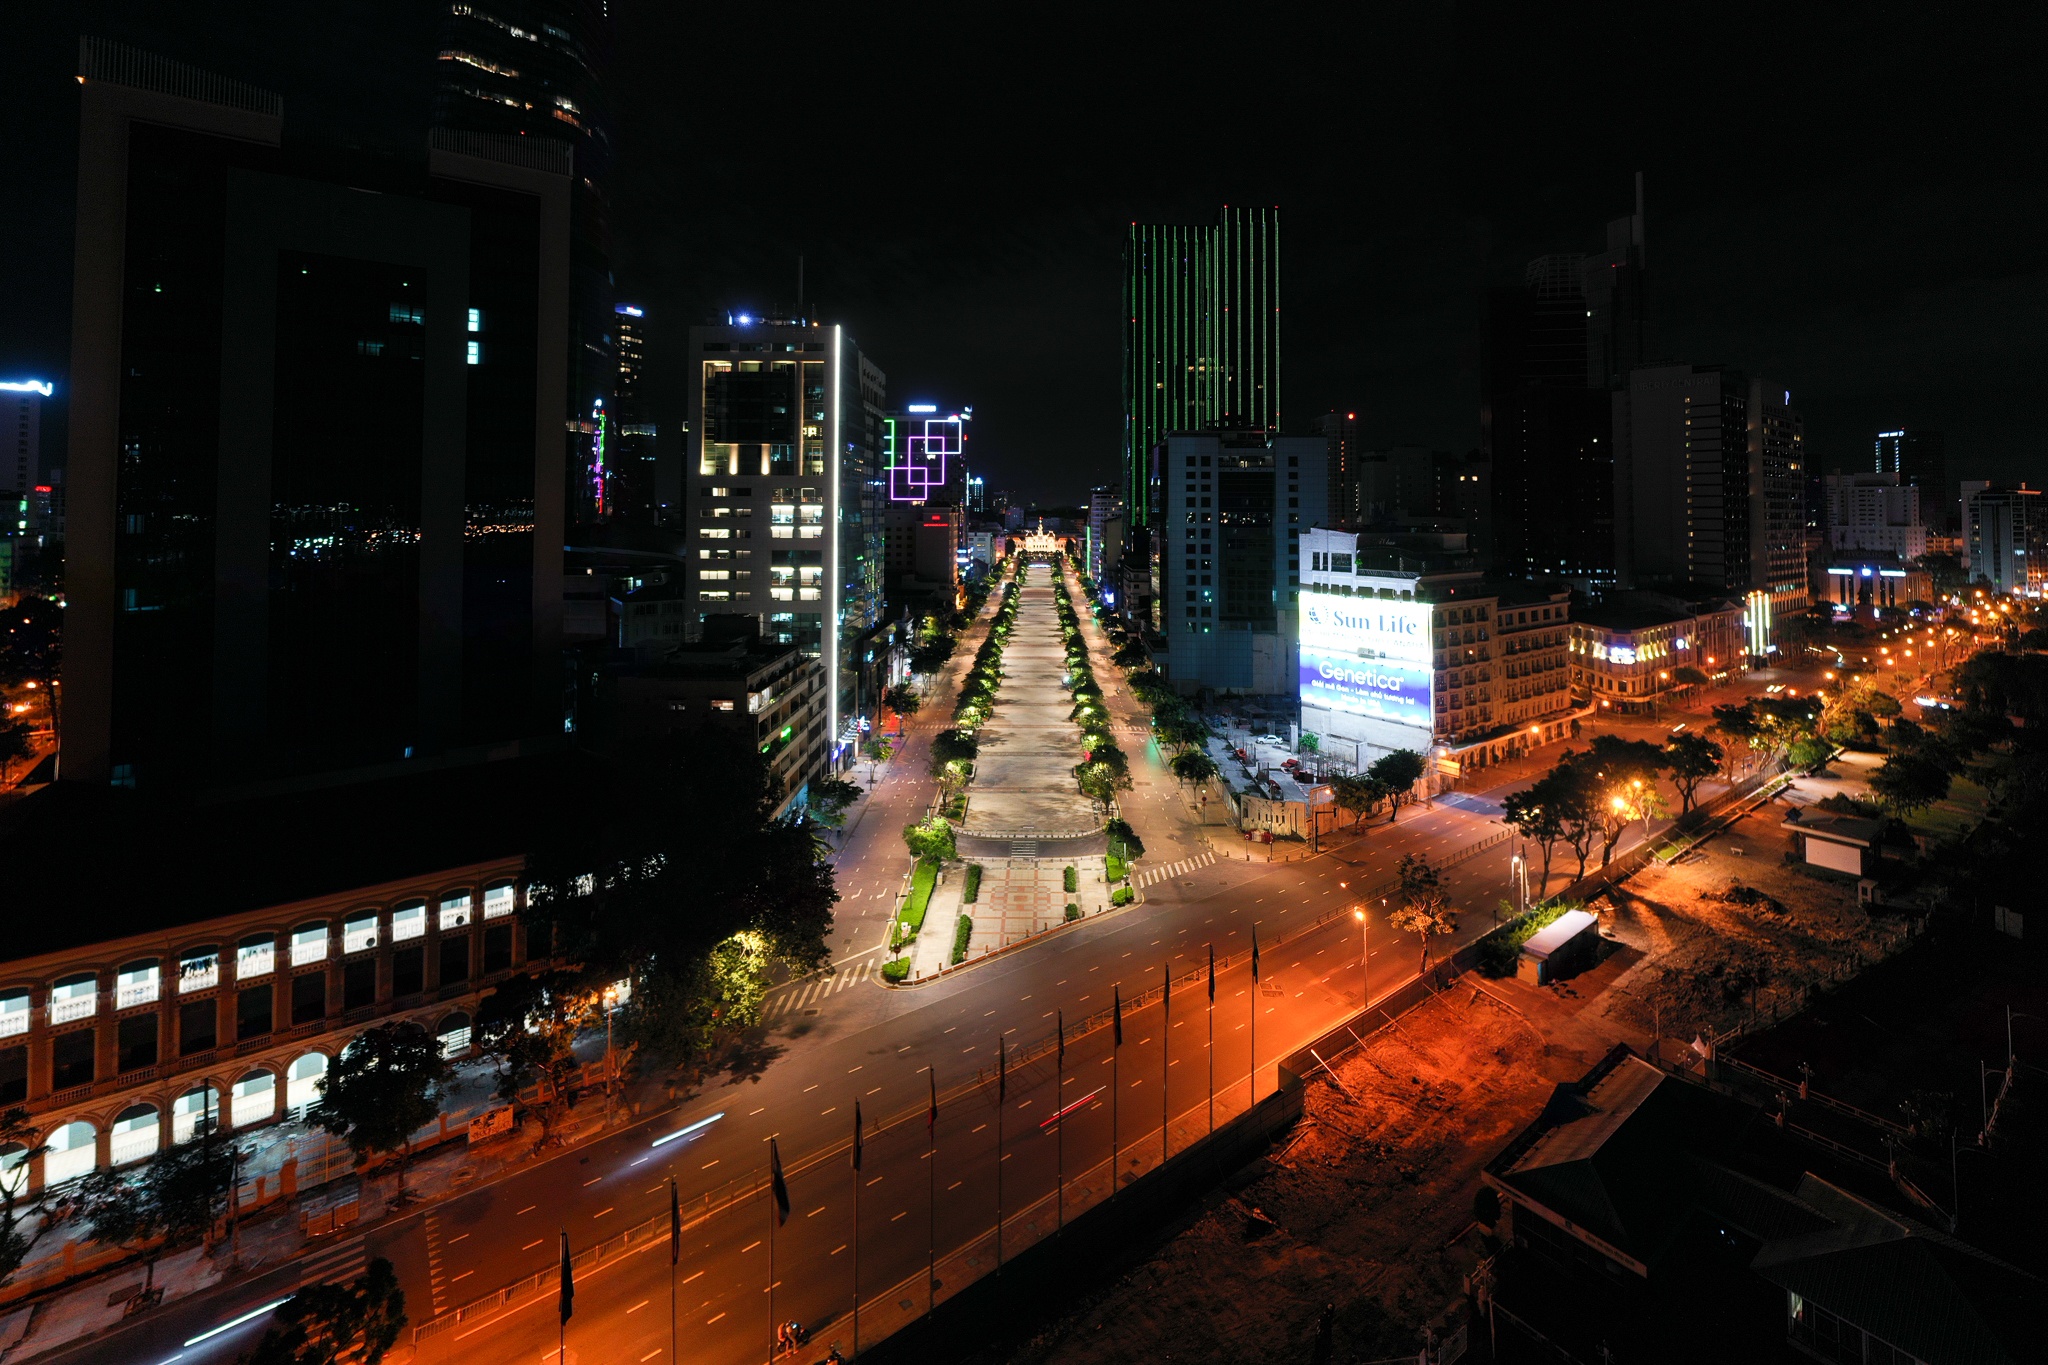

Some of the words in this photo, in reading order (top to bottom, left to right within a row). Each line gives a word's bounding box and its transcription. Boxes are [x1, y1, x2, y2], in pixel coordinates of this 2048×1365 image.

[1634, 380, 1670, 391] LIBERTY
[1333, 610, 1370, 630] Sun
[1379, 614, 1417, 635] Life
[1319, 661, 1402, 691] Genetica
